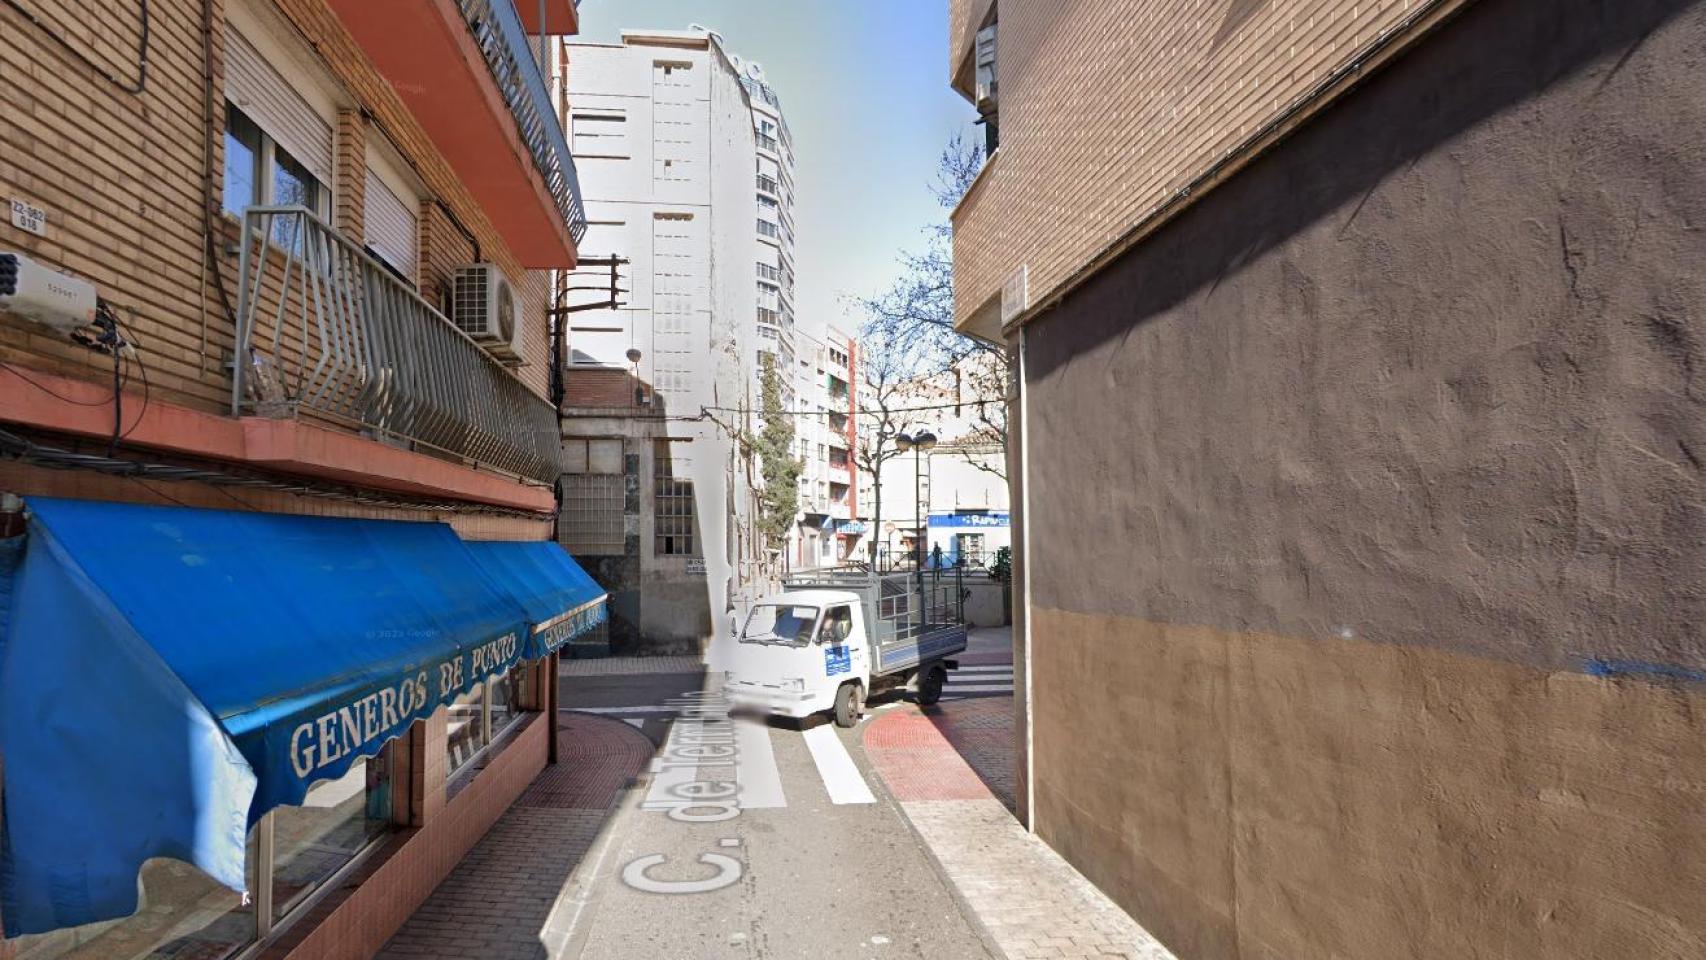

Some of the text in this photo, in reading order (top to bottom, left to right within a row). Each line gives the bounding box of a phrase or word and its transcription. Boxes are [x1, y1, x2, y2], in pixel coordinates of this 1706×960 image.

[290, 632, 517, 778] GENEROS DE PUNTO
